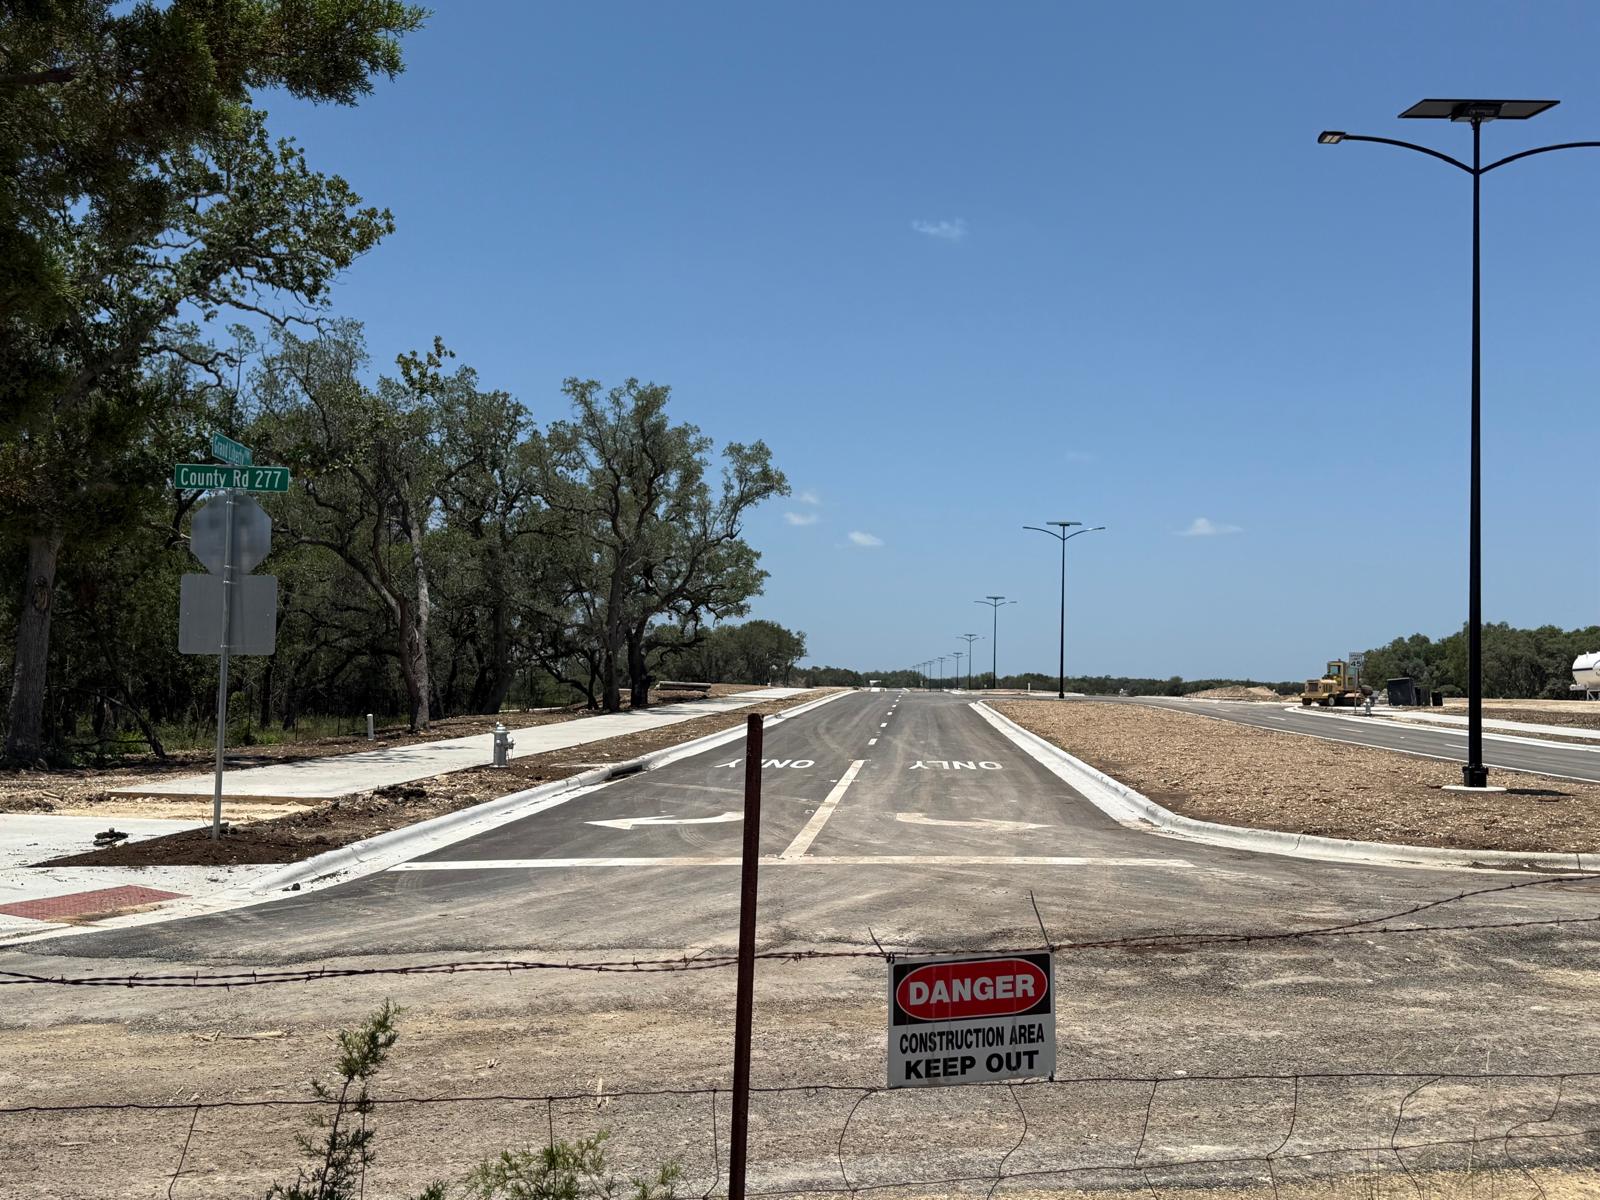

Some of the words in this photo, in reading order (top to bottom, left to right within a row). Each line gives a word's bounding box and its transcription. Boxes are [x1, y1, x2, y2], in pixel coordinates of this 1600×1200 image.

[180, 467, 227, 488] County
[232, 469, 249, 487] Rd
[254, 470, 282, 489] 277
[908, 760, 1003, 770] ONLY
[908, 974, 1036, 1006] DANGER
[899, 1026, 1005, 1055] CONSTRUCTION
[1009, 1023, 1045, 1045] AREA
[905, 1055, 976, 1080] KEEP
[985, 1050, 1039, 1073] OUT
